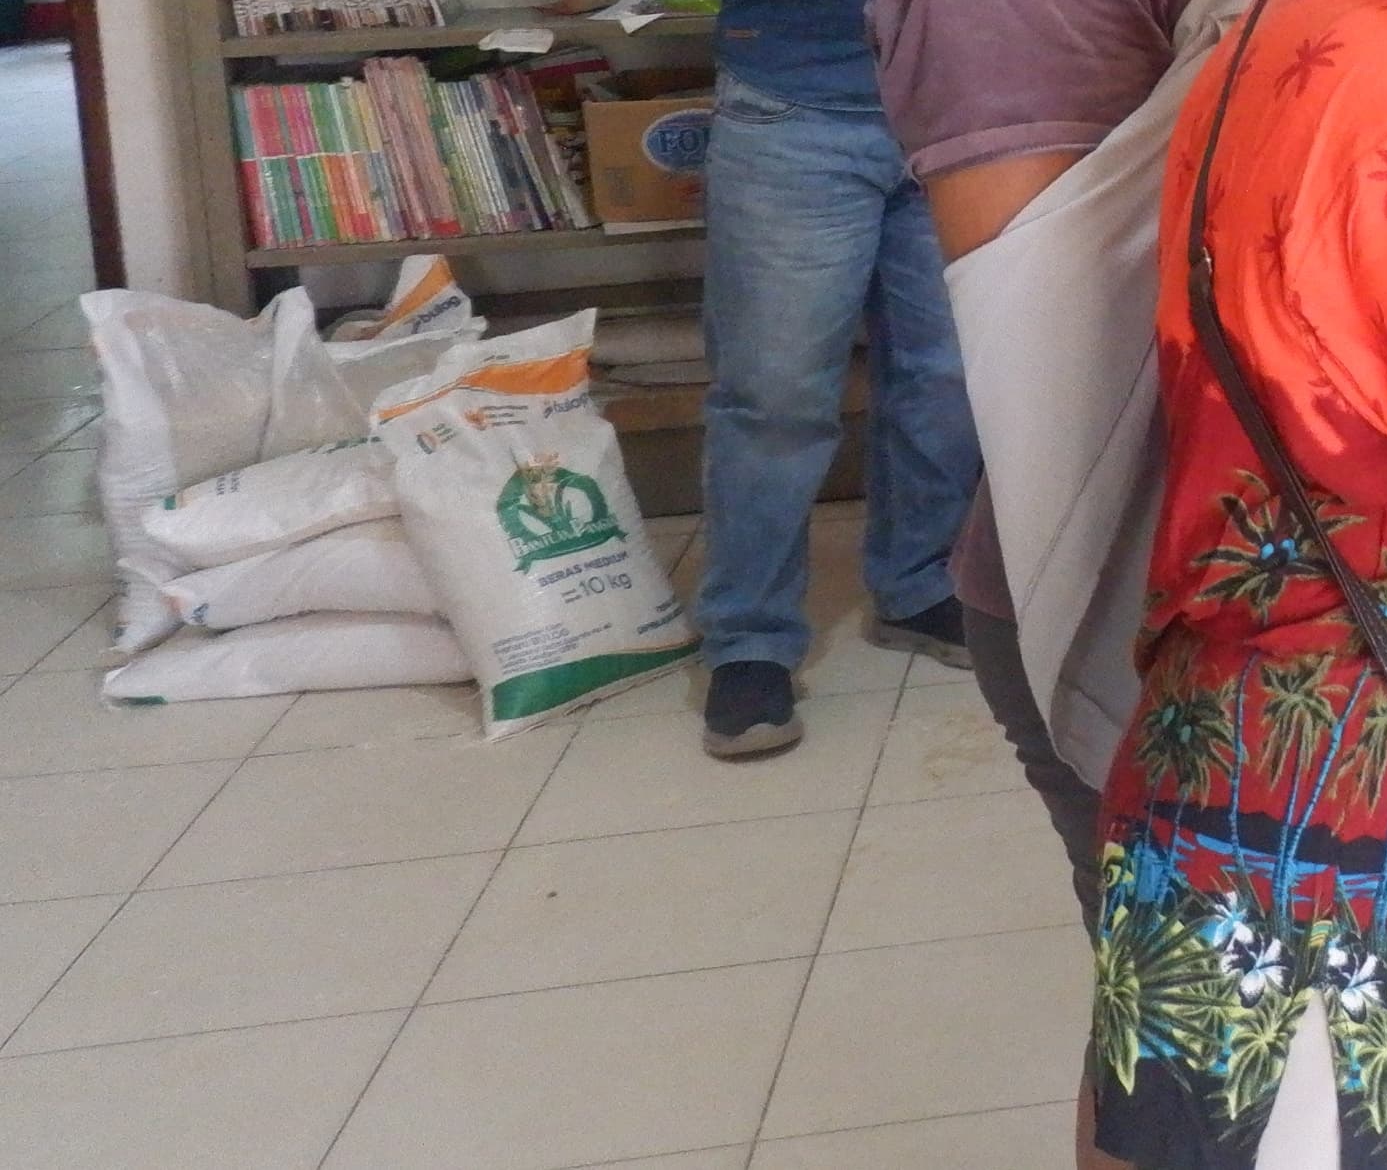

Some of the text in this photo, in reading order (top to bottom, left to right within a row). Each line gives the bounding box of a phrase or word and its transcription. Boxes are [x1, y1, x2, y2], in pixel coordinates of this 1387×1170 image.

[420, 296, 461, 323] bulog
[553, 392, 588, 413] bulog
[538, 564, 582, 587] BERAS
[609, 572, 633, 590] kg
